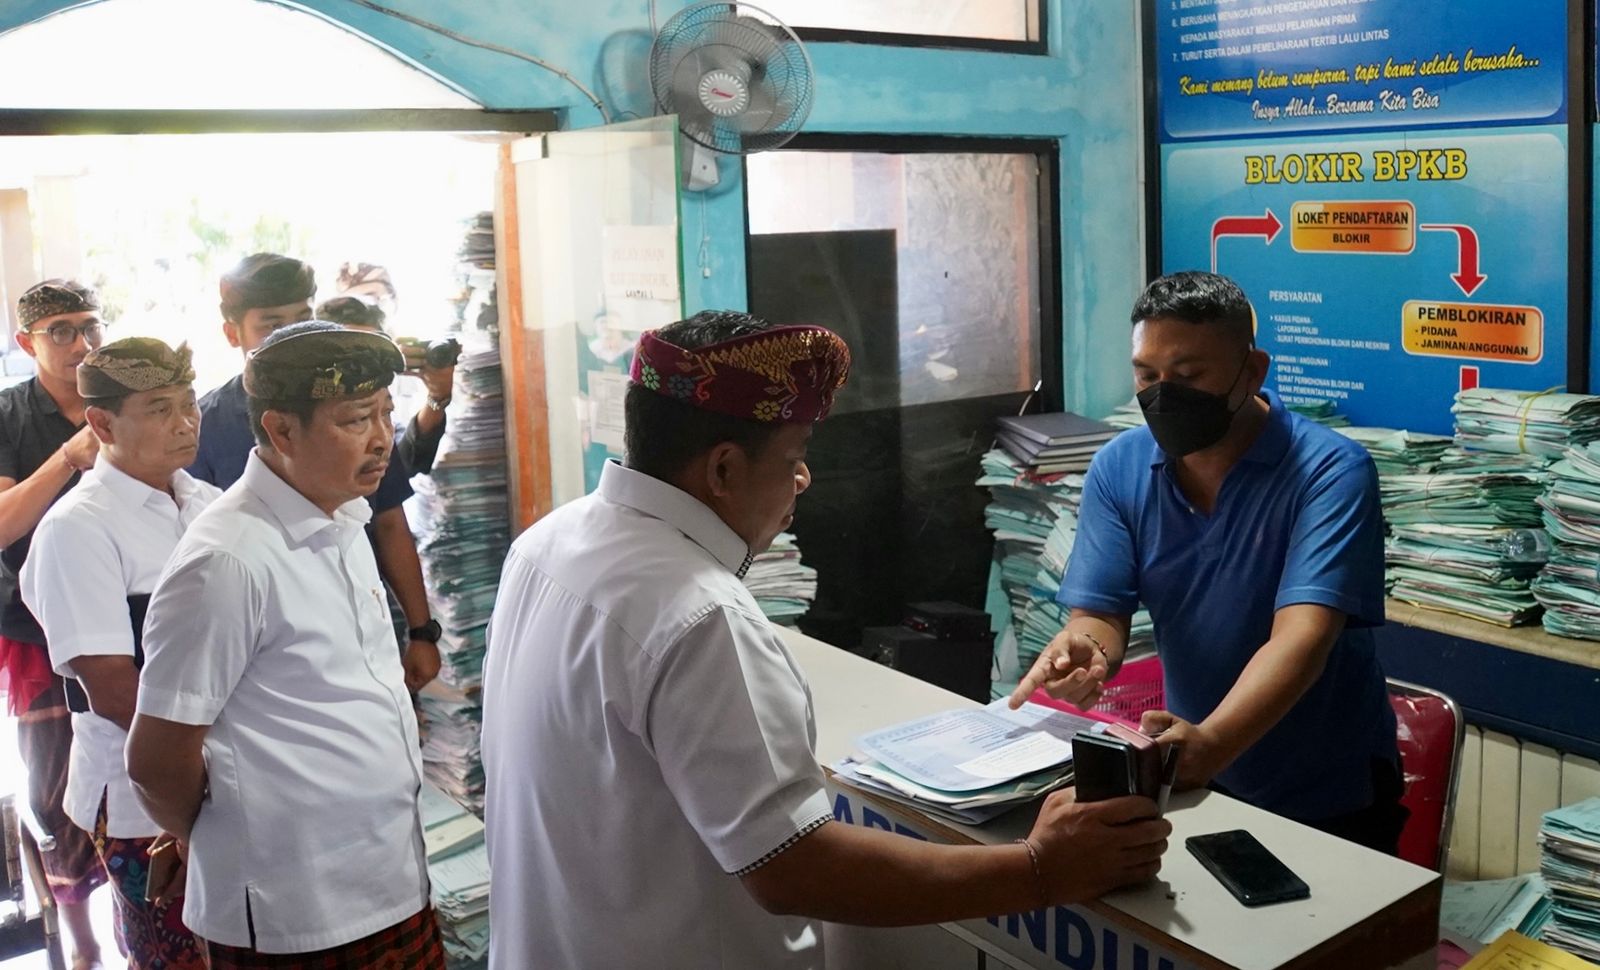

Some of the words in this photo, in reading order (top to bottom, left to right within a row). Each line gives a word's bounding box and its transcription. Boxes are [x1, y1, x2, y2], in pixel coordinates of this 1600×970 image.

[1181, 13, 1216, 26] BERUSAHA
[1218, 4, 1272, 21] MENINGKATKAN
[1274, 0, 1329, 13] PENGETAHUAN
[1181, 33, 1207, 44] KEPADA
[1208, 27, 1254, 41] MASYARAKAT
[1256, 22, 1285, 34] MENUJU
[1287, 16, 1330, 31] PELAYANAN
[1332, 13, 1357, 25] PRIMA
[1181, 50, 1203, 61] TURUT
[1203, 47, 1226, 59] SERTA
[1227, 44, 1251, 57] DALAM
[1252, 38, 1309, 53] PEMELIHARAAN
[1311, 34, 1337, 47] TERTIB
[1339, 31, 1360, 44] LALU
[1361, 28, 1389, 42] LINTAS
[1179, 75, 1209, 97] Kami
[1211, 77, 1253, 95] memang
[1257, 69, 1289, 89] belum
[1354, 63, 1380, 85] tapi
[1384, 57, 1416, 79] kami
[1419, 53, 1460, 76] selalu
[1252, 99, 1280, 123] Insya
[1379, 89, 1407, 112] Kita
[1411, 87, 1440, 109] Bisa
[1245, 152, 1364, 184] BLOKIR
[1373, 148, 1467, 182] BPKB
[1297, 211, 1329, 224] LOKET
[1332, 211, 1408, 225] PENDAFTARAN
[1332, 233, 1371, 244] BLOKIR
[1269, 289, 1322, 304] PERSYARATAN
[1418, 306, 1526, 326] PEMBLOKIRAN
[1421, 326, 1457, 338] PIDANA
[1331, 339, 1350, 348] BLOKIR
[1351, 340, 1364, 349] DARI
[1421, 339, 1528, 356] JAMINAN/ANGGUNAN
[1278, 384, 1292, 393] BANK
[1293, 385, 1326, 397] PEMERINTAH
[1326, 389, 1348, 400] MAUPUN
[1331, 379, 1350, 388] BLOKIR
[1351, 381, 1364, 390] DARI
